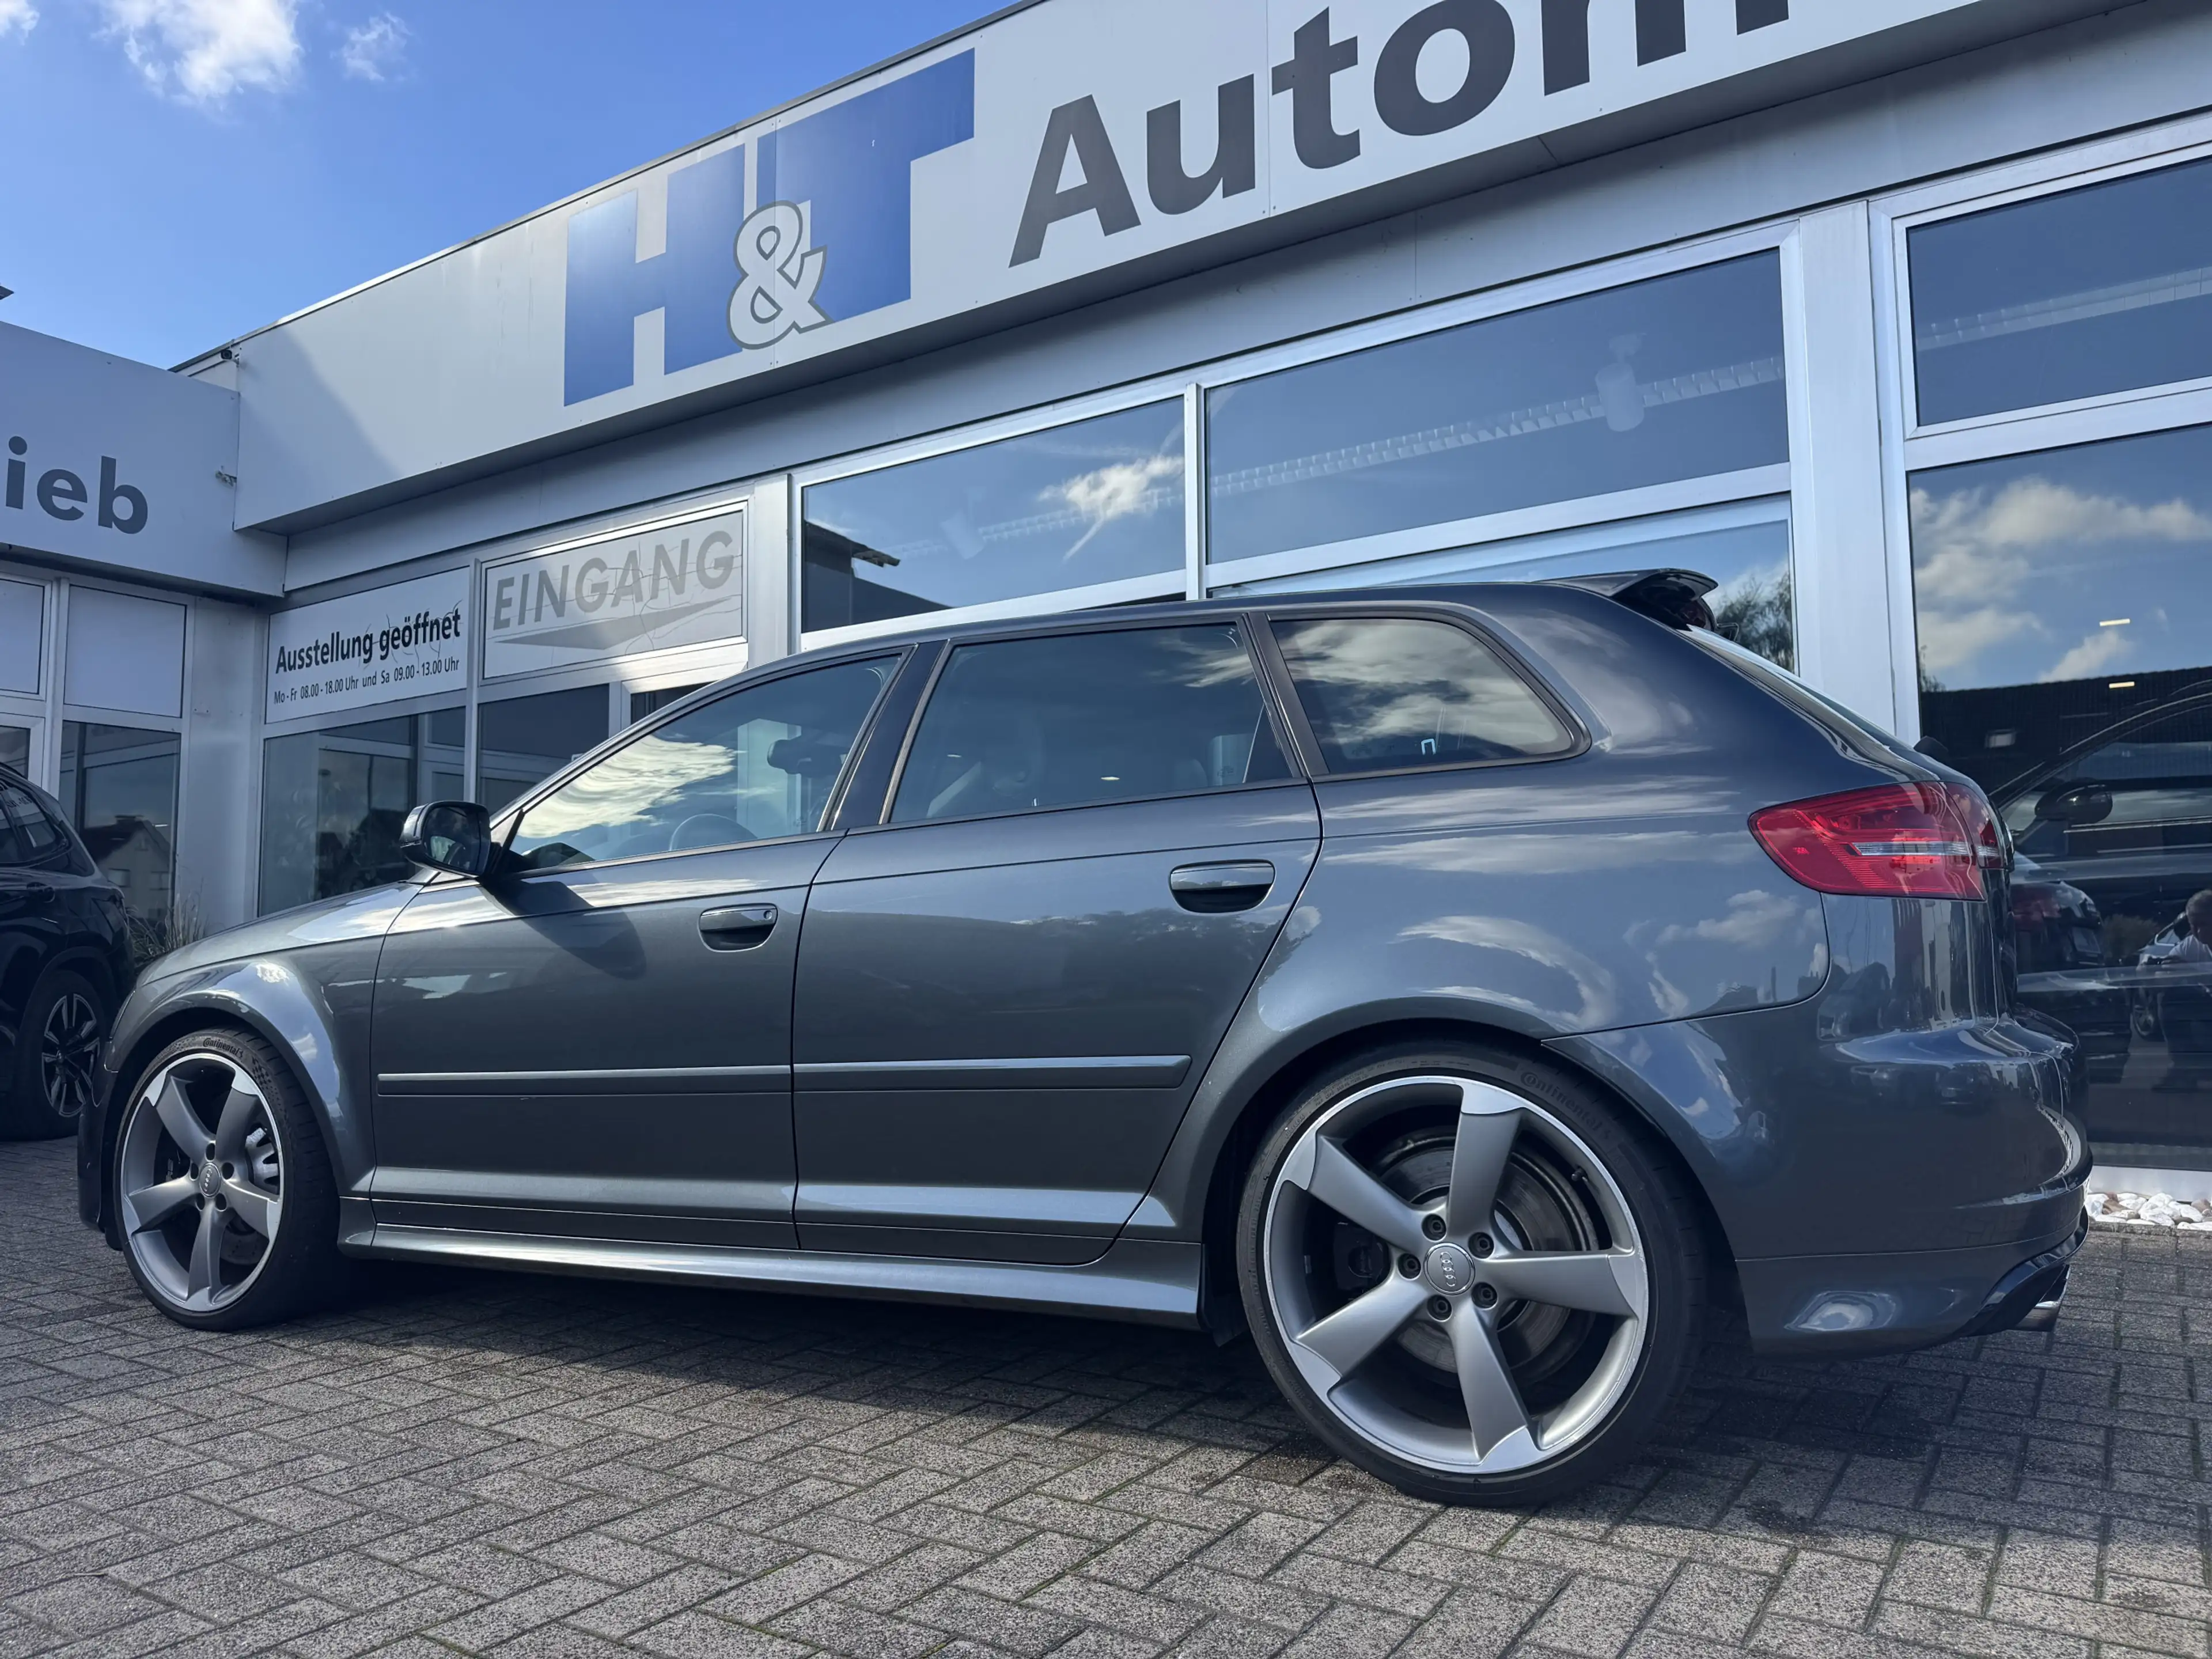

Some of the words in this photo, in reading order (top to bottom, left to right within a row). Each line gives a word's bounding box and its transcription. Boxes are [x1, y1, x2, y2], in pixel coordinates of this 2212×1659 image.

[564, 48, 975, 407] H&T
[493, 531, 734, 631] EINGANG
[275, 631, 373, 674] Ausstellung
[379, 608, 460, 661] geöffnet
[300, 683, 319, 699] 08.00
[325, 679, 343, 695] 18.00
[346, 675, 359, 691] Uhr
[362, 671, 377, 688] und
[381, 670, 390, 684] Sa
[394, 664, 415, 681] 09.00
[422, 658, 442, 676] 13.00
[445, 656, 460, 672] Uhr
[203, 1037, 240, 1056] Continental
[1520, 1071, 1603, 1132] Continental
